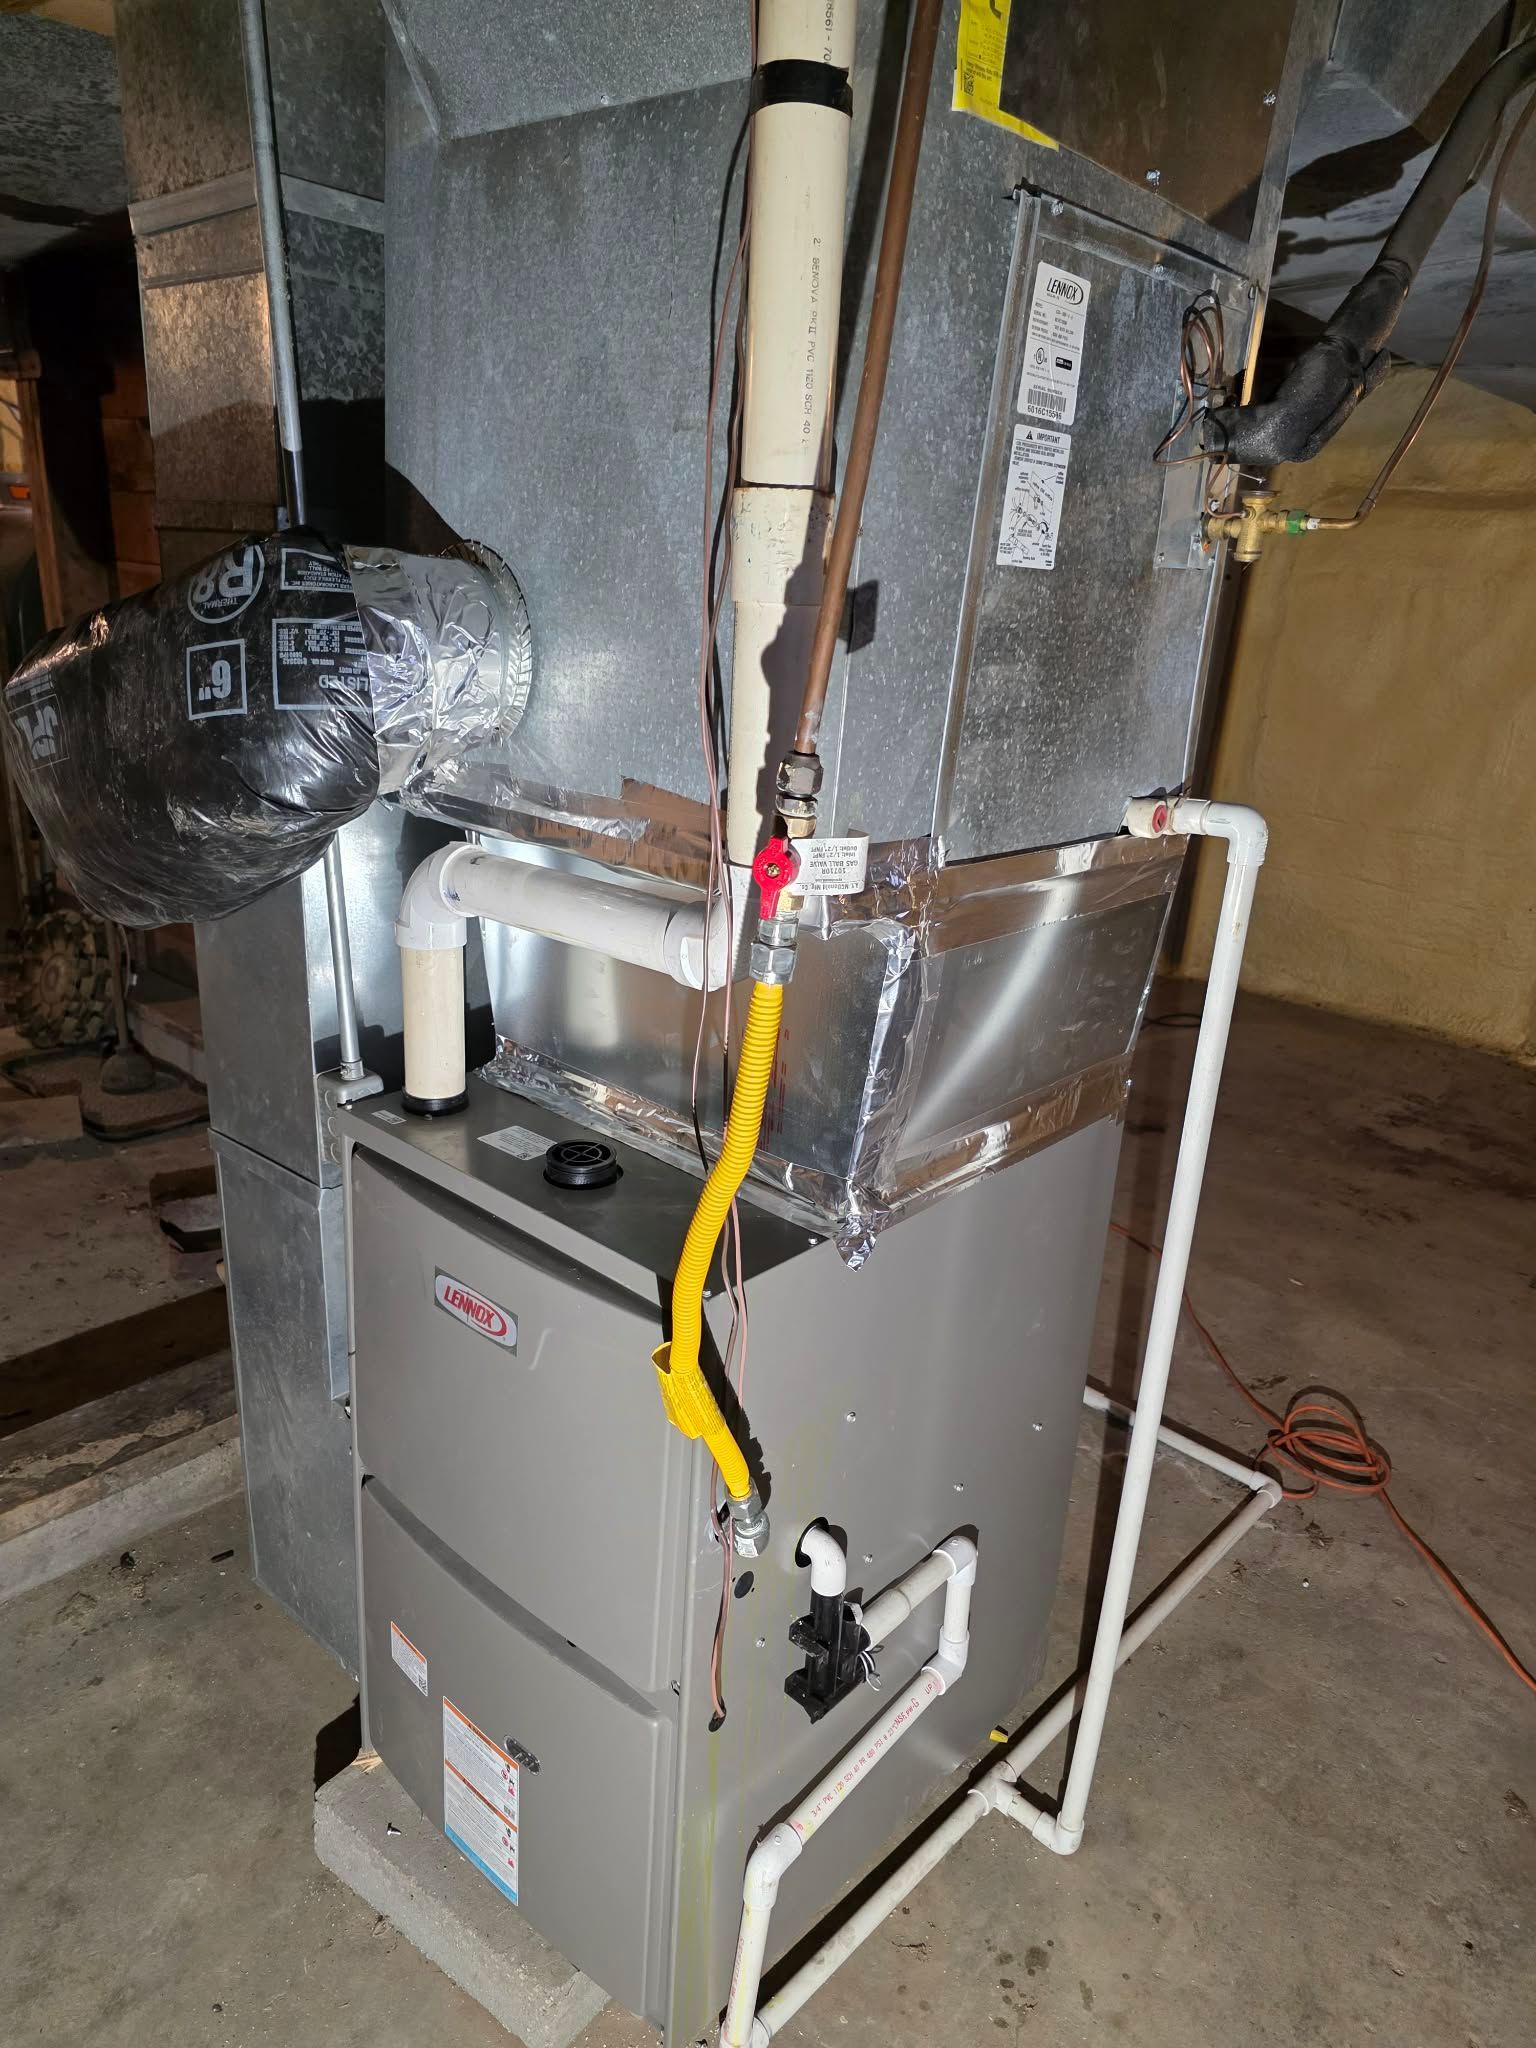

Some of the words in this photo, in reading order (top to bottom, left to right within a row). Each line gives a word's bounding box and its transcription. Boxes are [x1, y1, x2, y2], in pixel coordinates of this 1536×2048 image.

[1046, 277, 1079, 301] LENNOX
[806, 341, 816, 362] PVC
[802, 419, 811, 434] 40
[1036, 432, 1061, 444] IMPORTANT
[203, 597, 238, 609] THERMAL
[198, 660, 231, 701] 6"
[318, 674, 369, 691] LISTED
[444, 1285, 495, 1328] LENNOX
[843, 1772, 854, 1782] SCH
